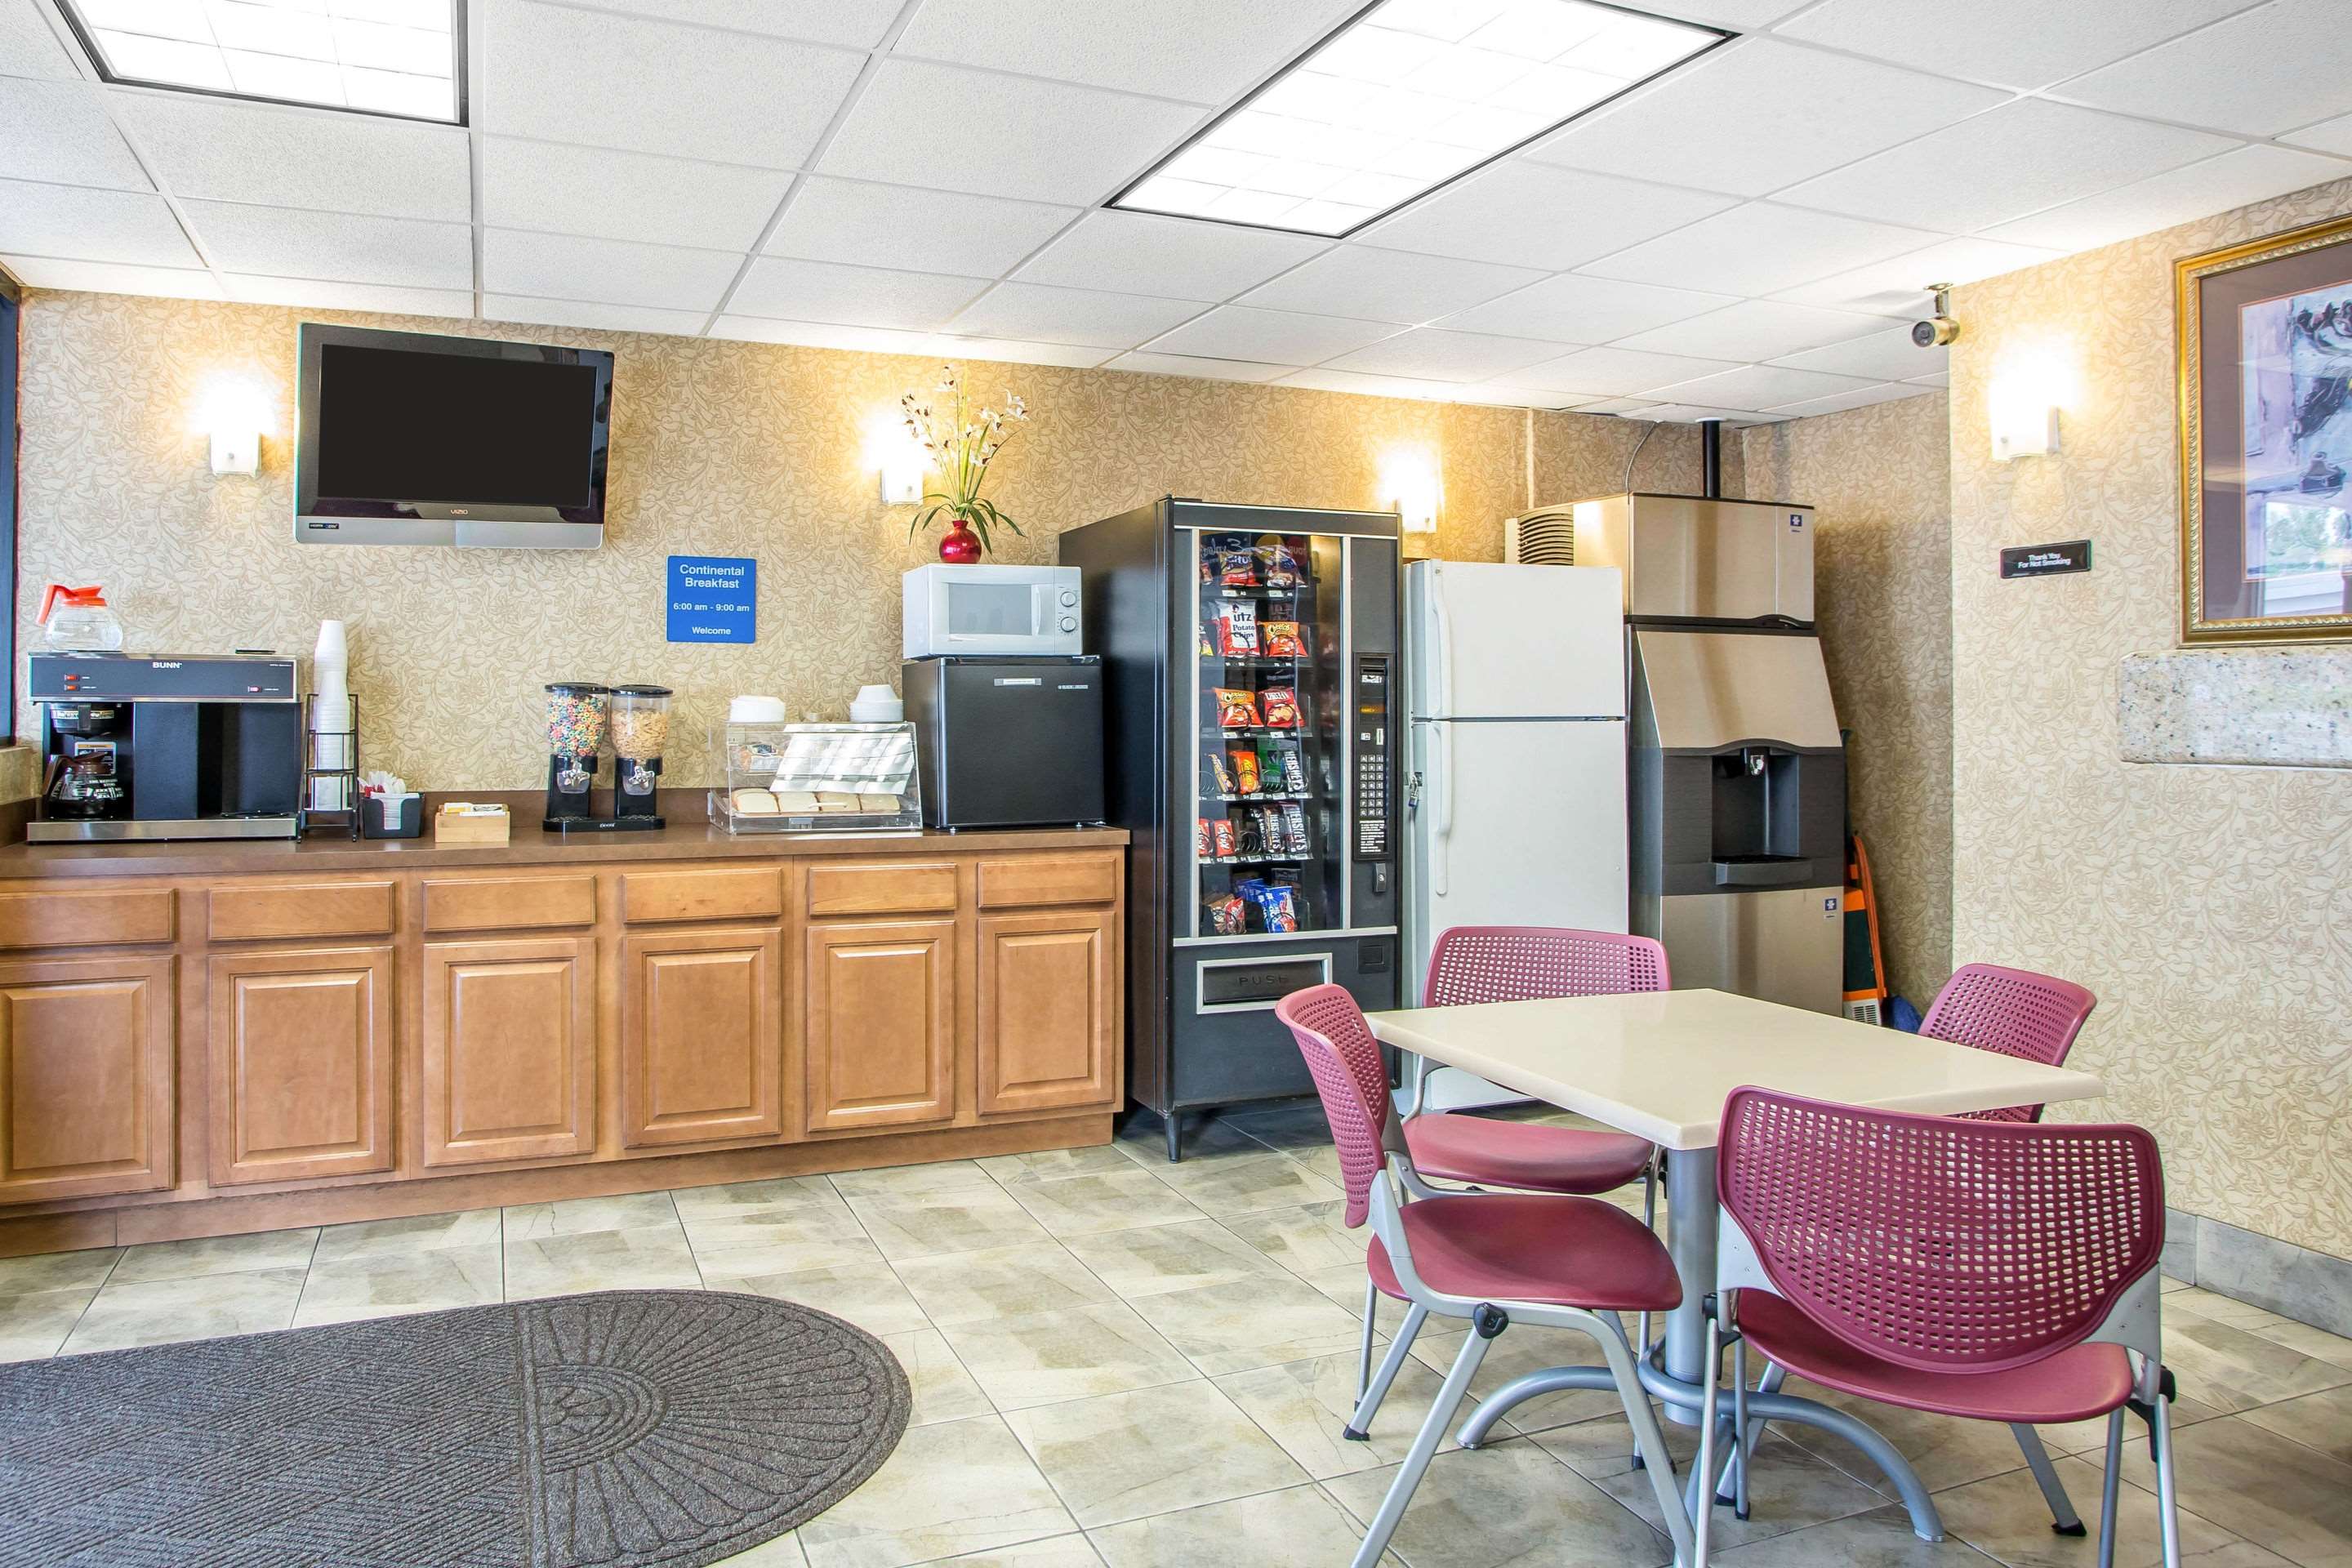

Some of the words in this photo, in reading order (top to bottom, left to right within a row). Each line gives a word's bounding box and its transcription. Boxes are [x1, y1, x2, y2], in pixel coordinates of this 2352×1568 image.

[679, 564, 745, 576] Continental
[685, 577, 739, 588] Breakfast
[673, 603, 693, 611] 6:00
